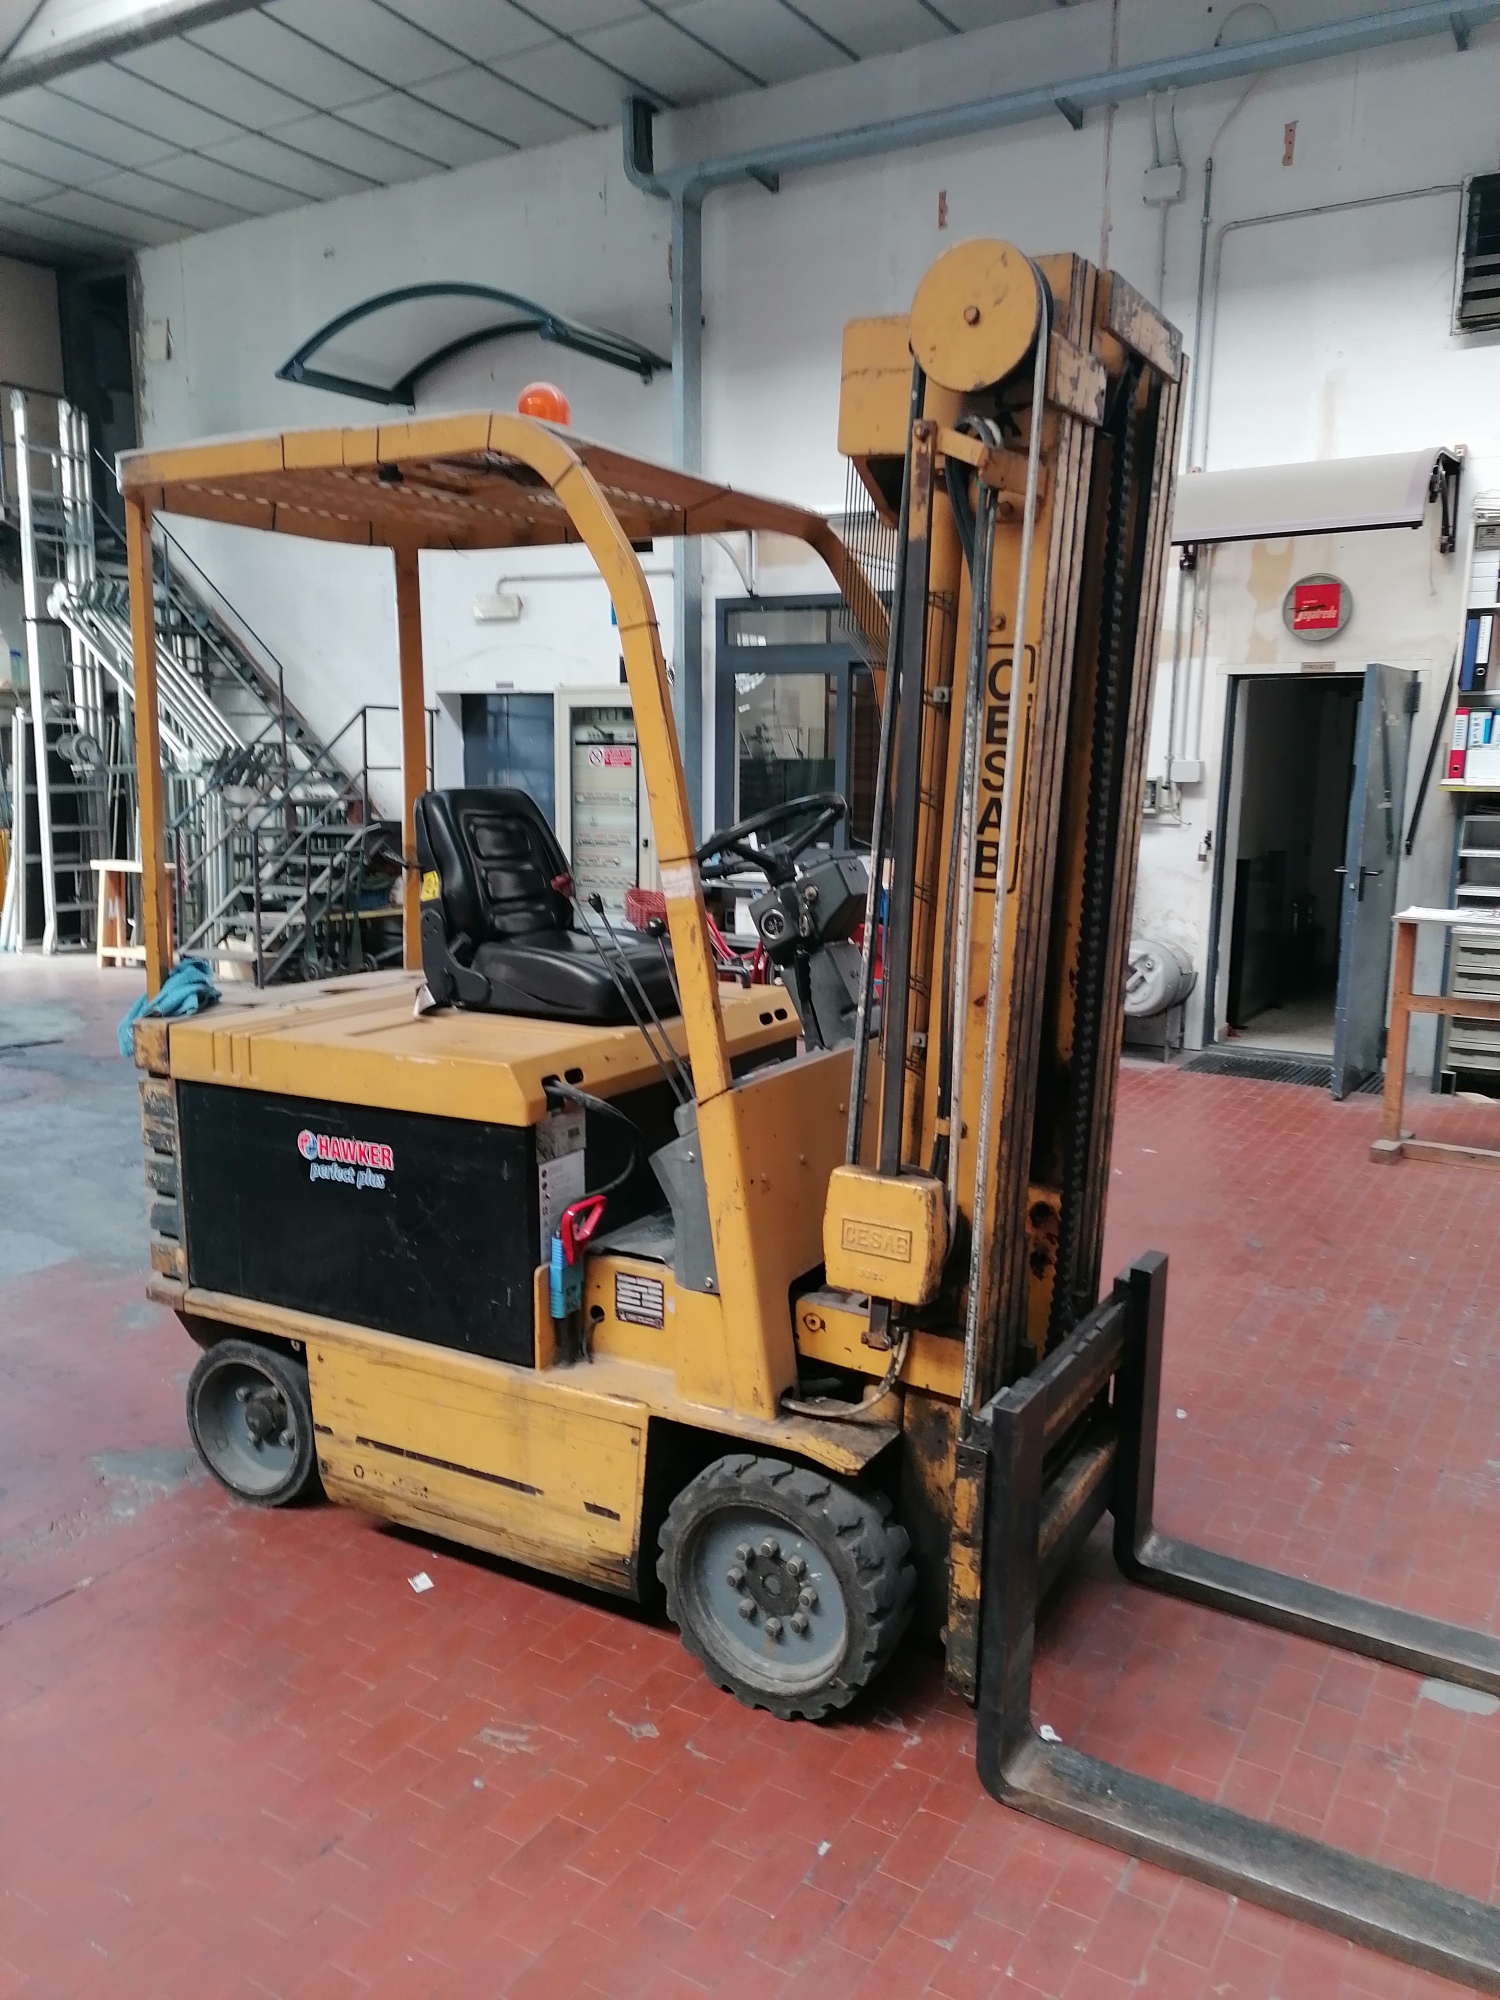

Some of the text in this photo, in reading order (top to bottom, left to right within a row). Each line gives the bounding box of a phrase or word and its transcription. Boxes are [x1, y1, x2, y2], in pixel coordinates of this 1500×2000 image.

[316, 1134, 395, 1171] HAWKER
[310, 1162, 386, 1189] perfect plus
[845, 1226, 908, 1254] CESAB
